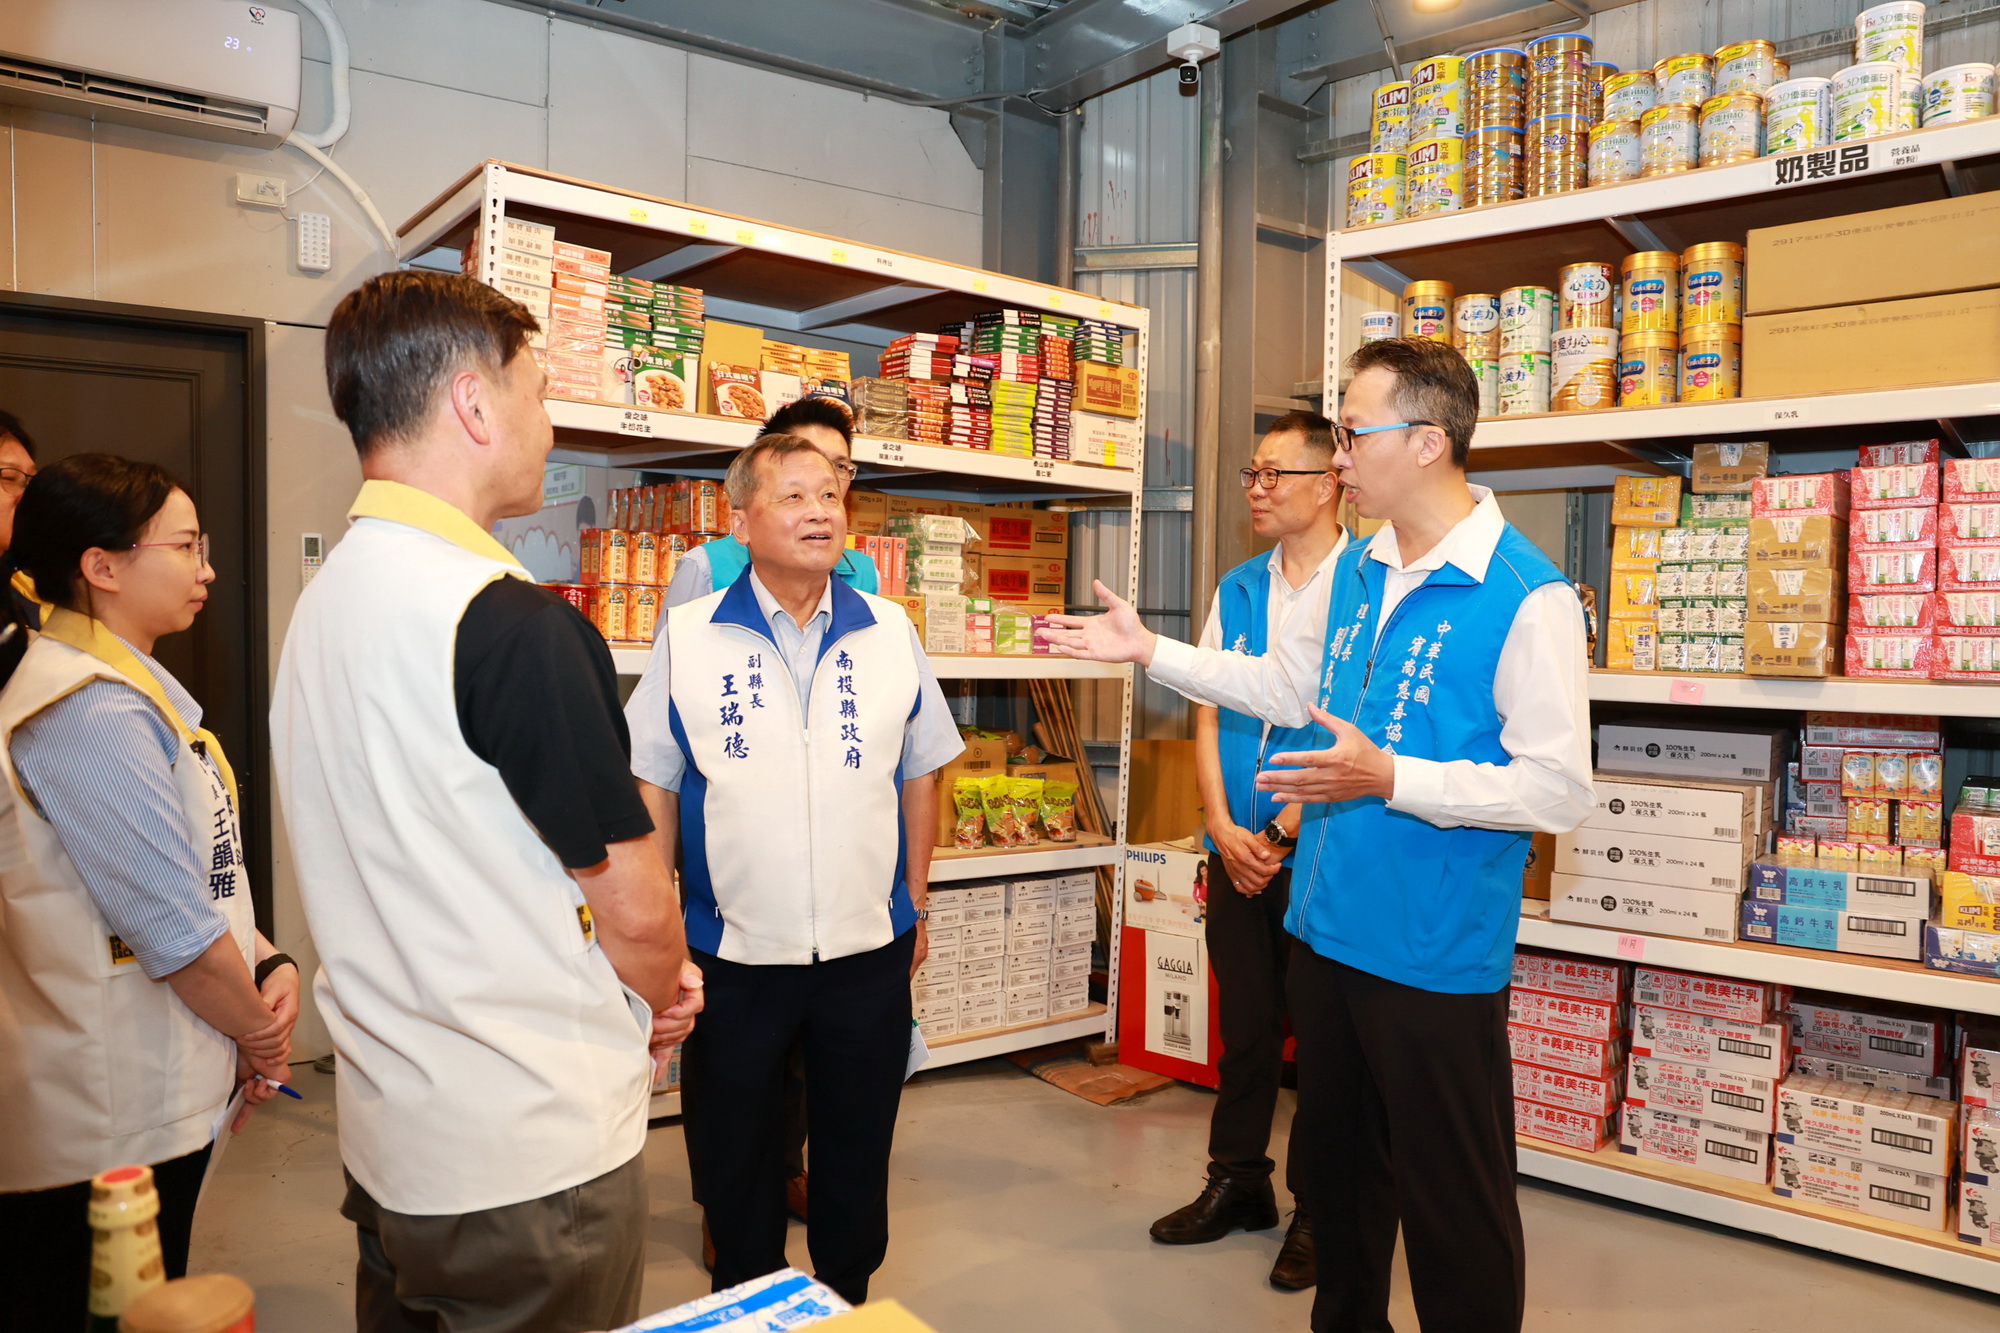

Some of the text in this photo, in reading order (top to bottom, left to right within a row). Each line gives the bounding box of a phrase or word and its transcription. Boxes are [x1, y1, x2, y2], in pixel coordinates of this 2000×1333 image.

[224, 36, 240, 50] 23
[1775, 144, 1869, 186] 奶製品
[1774, 409, 1800, 420] 保久乳
[1413, 620, 1452, 706] 中華民國
[747, 653, 765, 709] 副縣長
[719, 673, 750, 759] 王瑞德
[835, 650, 863, 769] 南投縣政府
[1670, 752, 1690, 760] 保久乳
[1630, 800, 1663, 810] 100%生乳
[1635, 808, 1658, 817] 保久乳
[209, 807, 236, 901] 王韻雅
[1126, 849, 1167, 865] PHILIPS
[1628, 848, 1661, 859] 100%生乳
[1633, 857, 1655, 866] 保久乳
[1666, 858, 1684, 866] 200ml
[1788, 876, 1844, 891] 高鈣牛乳
[1622, 897, 1655, 908] 100%生乳
[1627, 906, 1649, 915] 保久乳
[1682, 909, 1691, 917] 24
[1959, 906, 1981, 915] KLIM
[1780, 914, 1835, 930] 高鈣牛乳
[1157, 955, 1193, 976] GAGGIA
[1564, 963, 1615, 983] 義美牛乳
[1164, 973, 1187, 982] MILANO
[1704, 982, 1759, 1003] 義美牛乳
[1558, 1001, 1607, 1021] 義美牛乳
[1686, 1031, 1693, 1039] 11
[1550, 1036, 1599, 1058] 義美牛乳
[1553, 1075, 1602, 1097] 義美牛乳
[1684, 1083, 1691, 1091] 11
[1544, 1109, 1593, 1132] 義美牛乳
[1830, 1111, 1864, 1125] 果汁牛乳
[1654, 1122, 1699, 1137] 光泉 高鈣牛乳
[1804, 1119, 1862, 1136] 保久乳好處一樣多
[1677, 1133, 1685, 1141] 11
[1828, 1167, 1862, 1182] 果汁牛乳
[1802, 1174, 1860, 1192] 保久乳好處一樣多
